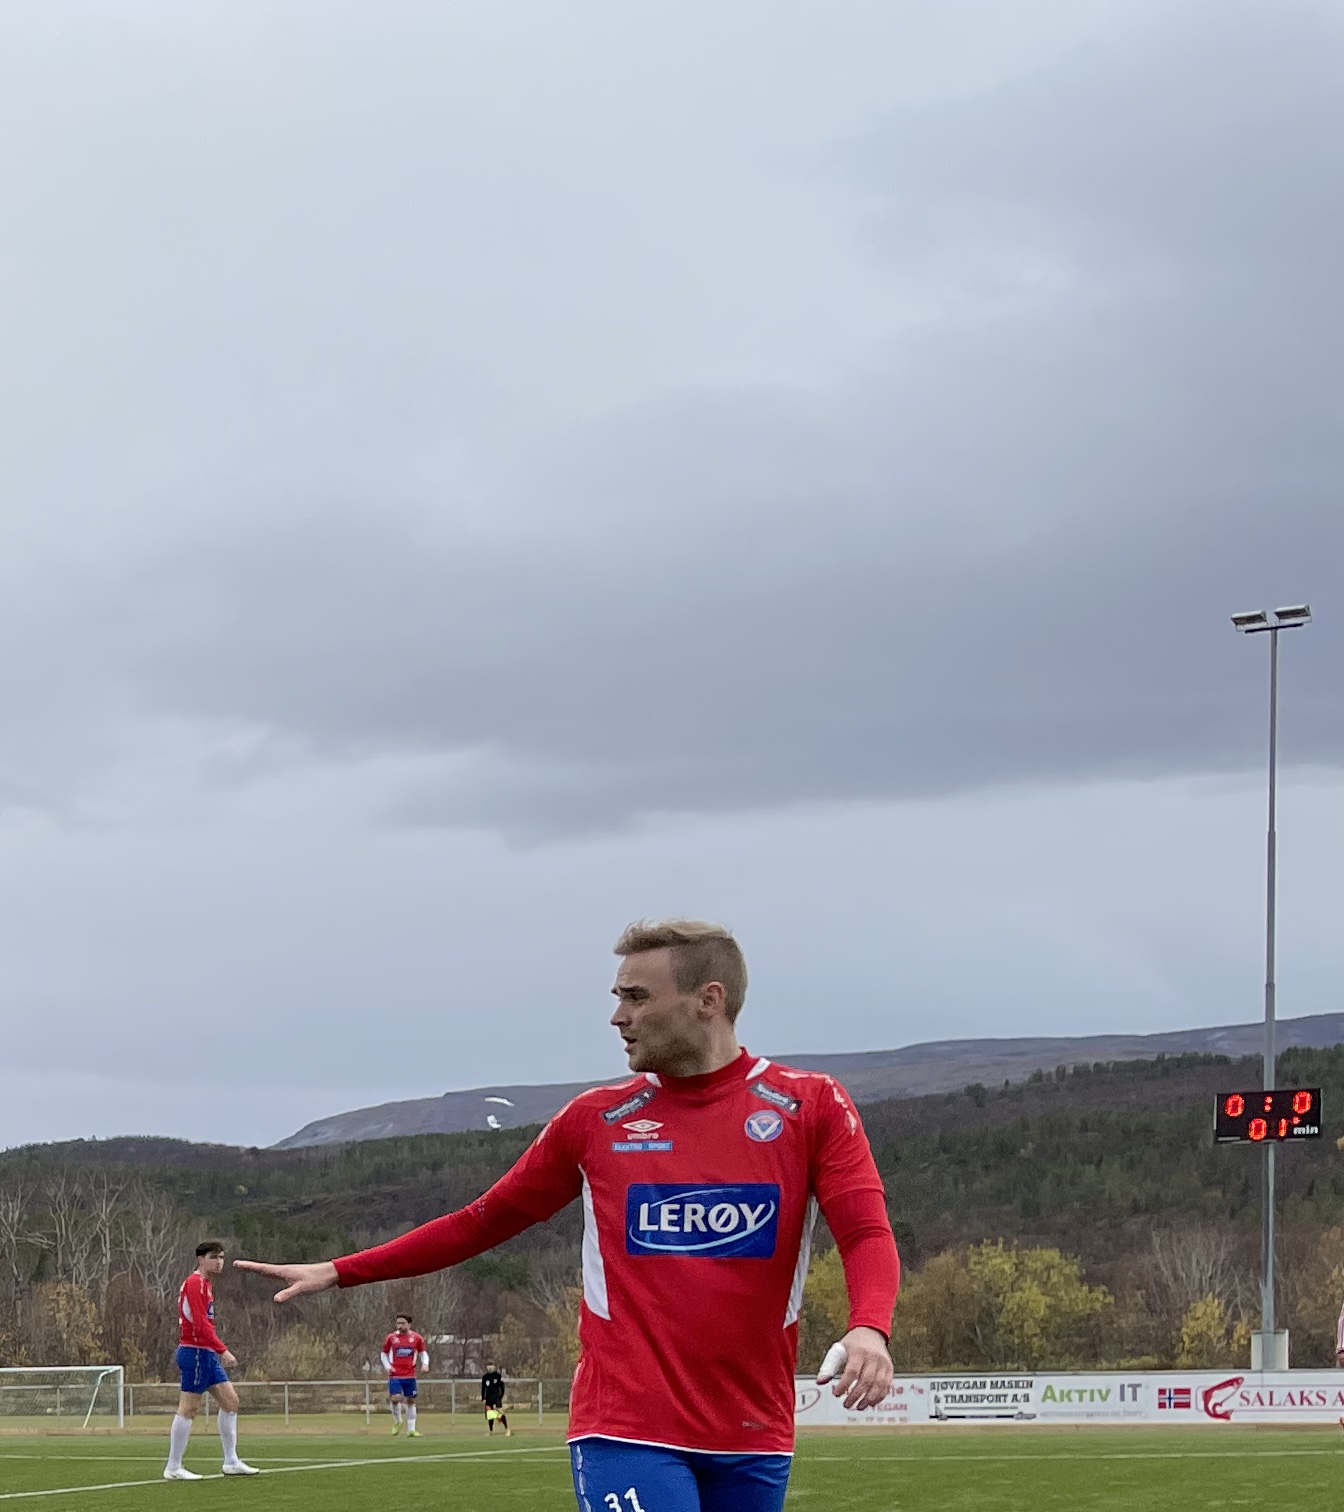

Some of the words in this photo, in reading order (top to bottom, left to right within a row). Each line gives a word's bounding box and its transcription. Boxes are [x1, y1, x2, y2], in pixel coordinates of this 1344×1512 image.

[1293, 1125, 1319, 1135] min
[639, 1202, 767, 1233] LERØY
[943, 1393, 1009, 1404] TRANSPORT
[1119, 1383, 1143, 1402] IT
[1239, 1389, 1327, 1408] SALAKS
